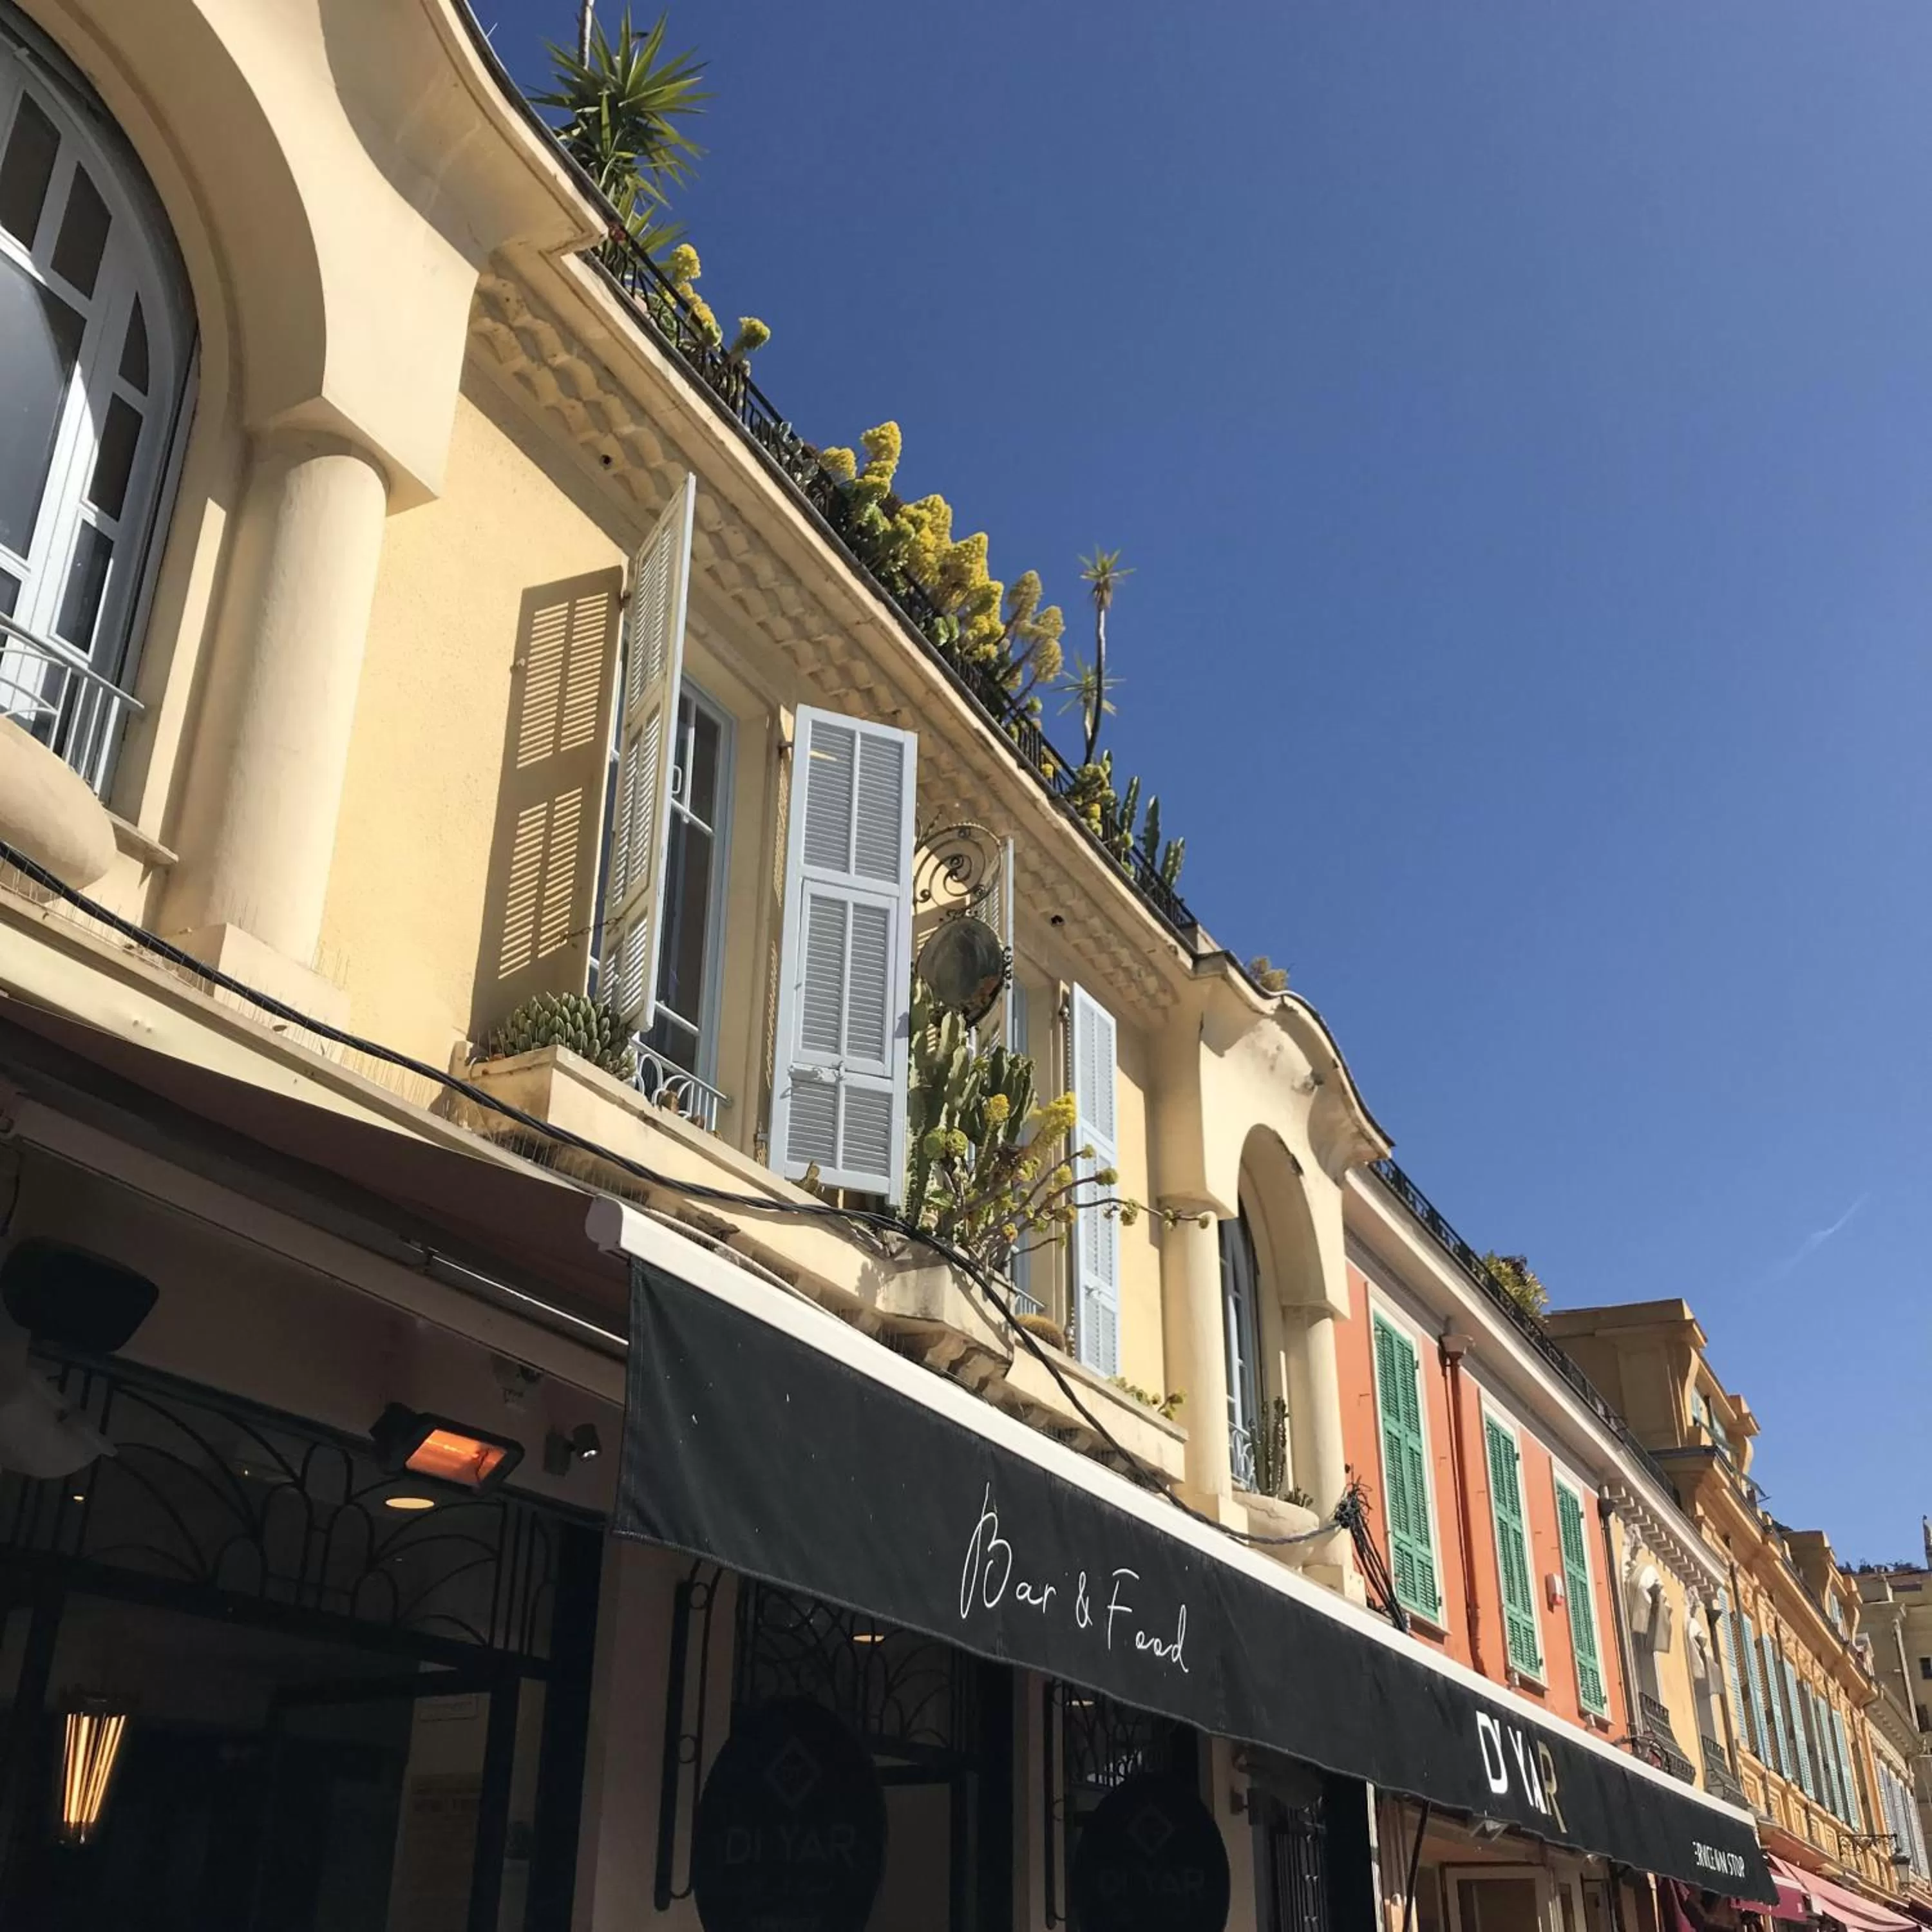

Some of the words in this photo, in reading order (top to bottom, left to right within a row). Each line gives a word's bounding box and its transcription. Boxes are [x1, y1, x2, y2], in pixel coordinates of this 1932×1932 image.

[960, 1481, 1057, 1619] Bar
[1075, 1571, 1093, 1629] &
[1107, 1567, 1189, 1674] Food
[725, 1826, 761, 1864] DI
[778, 1823, 856, 1869] YAR
